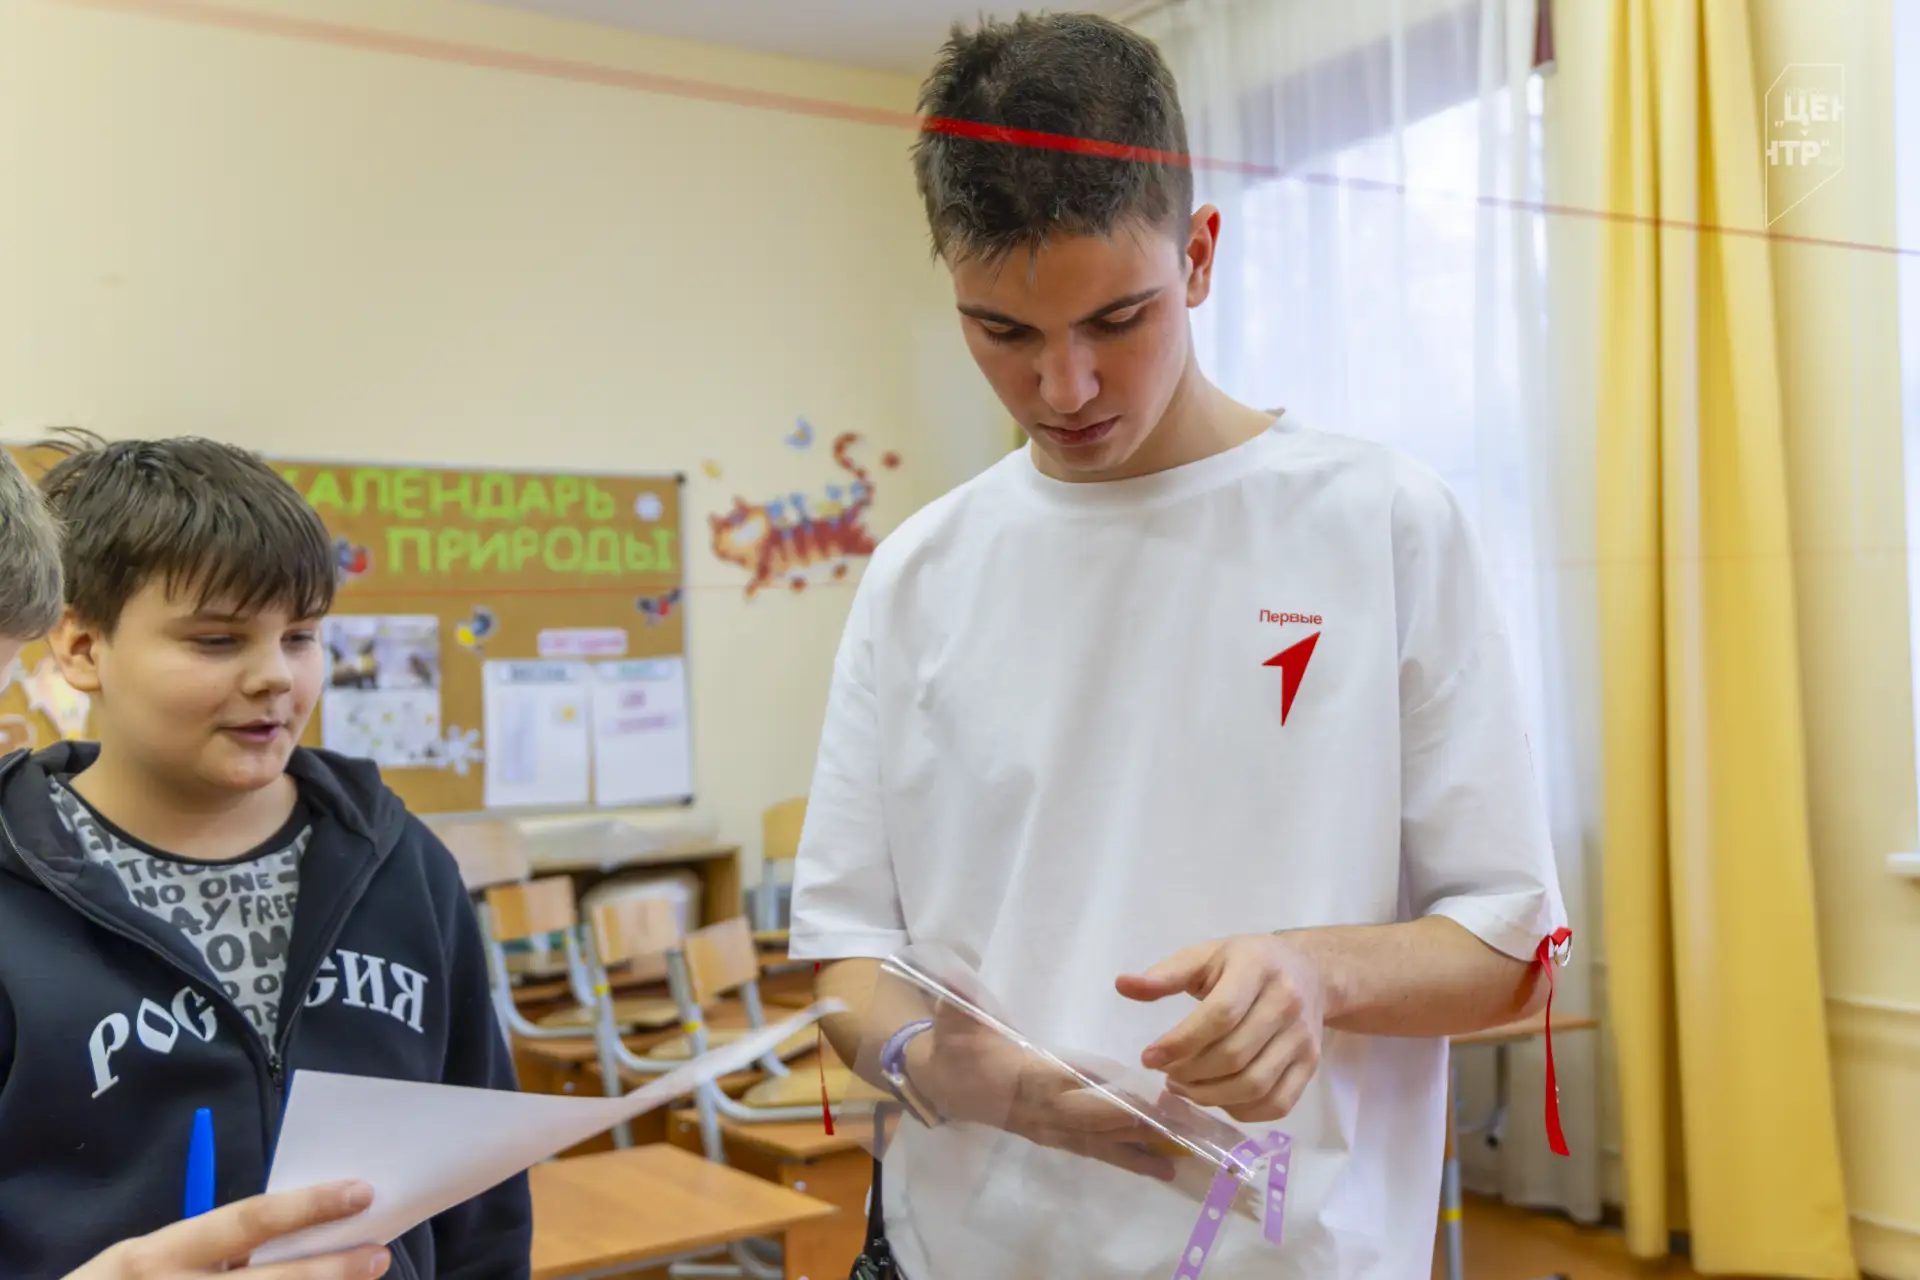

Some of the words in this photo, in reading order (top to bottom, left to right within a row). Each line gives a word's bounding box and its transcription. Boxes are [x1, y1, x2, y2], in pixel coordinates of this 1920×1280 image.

[283, 468, 615, 521] АЛЕНДАРЬ
[385, 526, 676, 575] ПРИРОДЫ
[1259, 608, 1323, 626] Первые
[131, 886, 186, 908] NO
[199, 872, 273, 899] ONE
